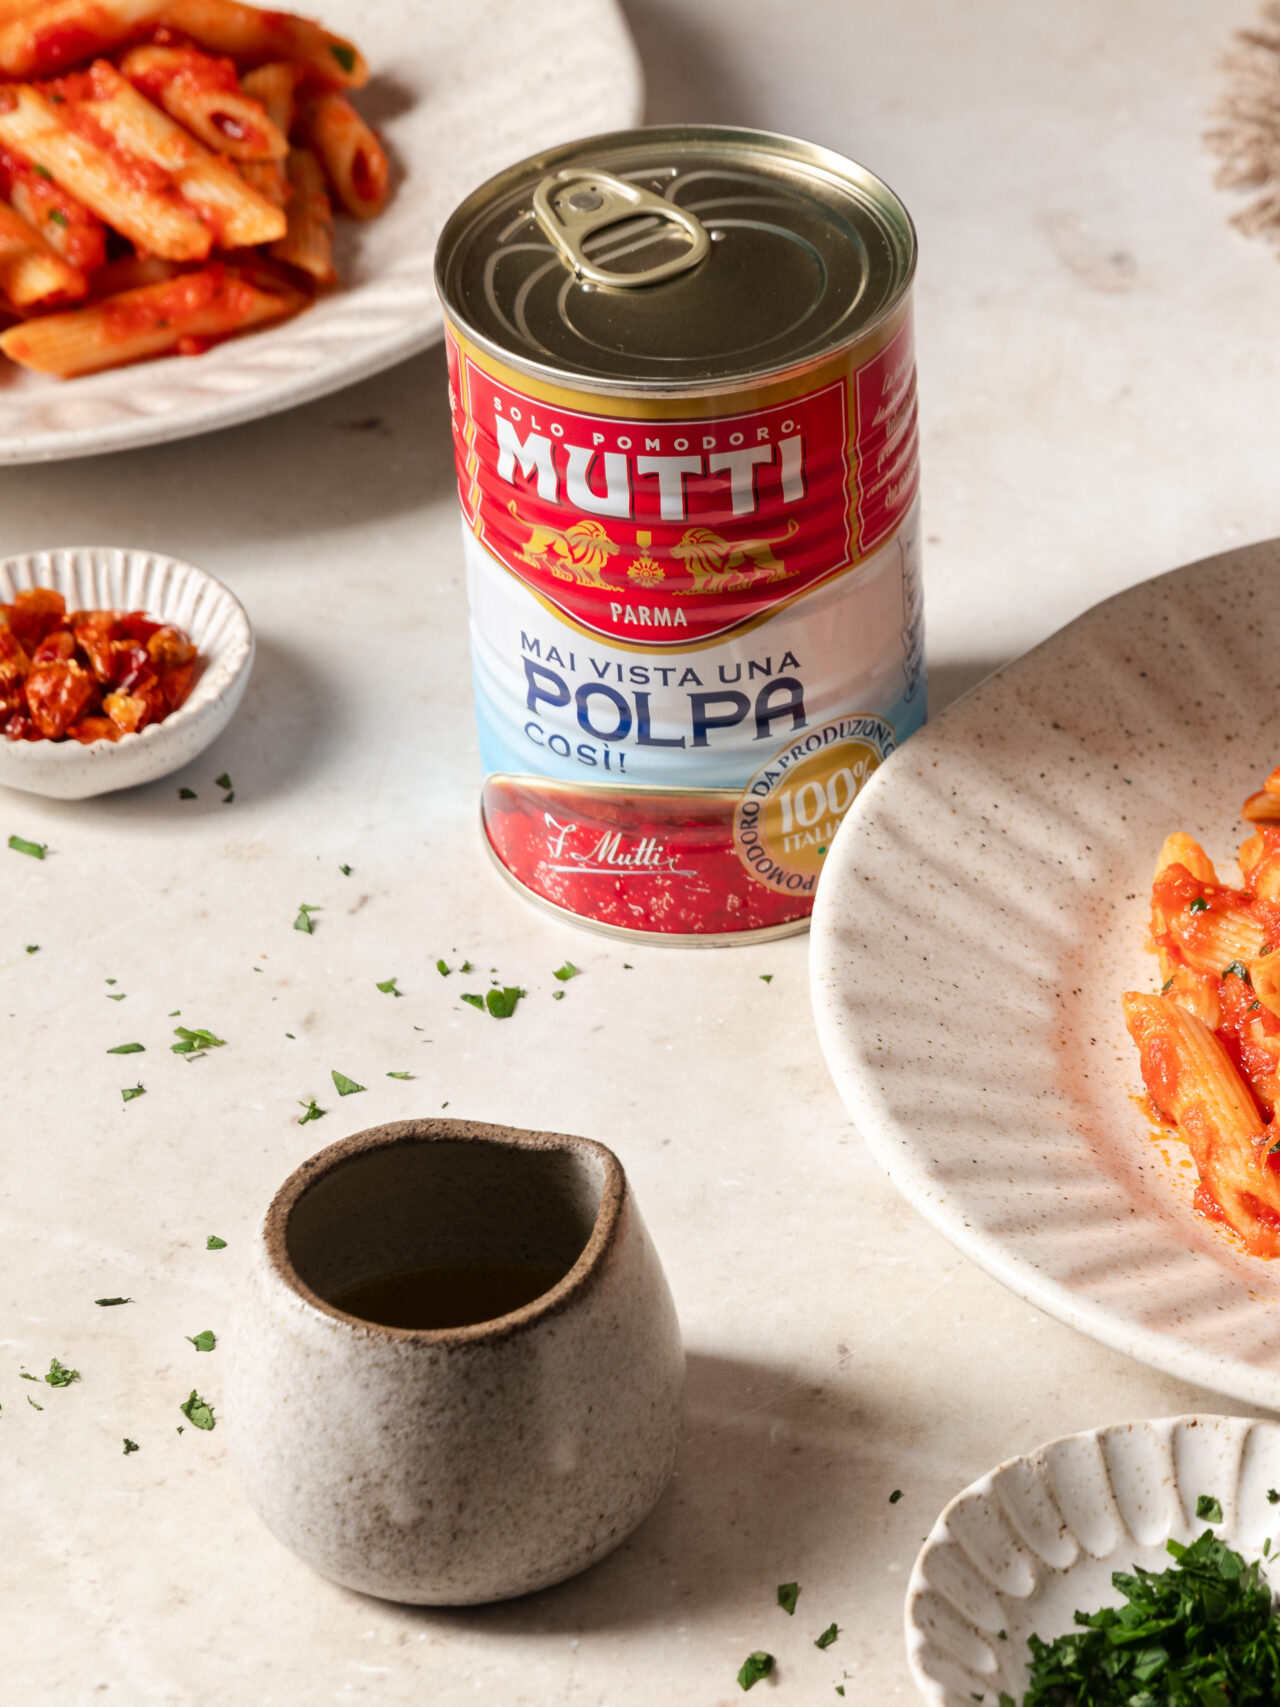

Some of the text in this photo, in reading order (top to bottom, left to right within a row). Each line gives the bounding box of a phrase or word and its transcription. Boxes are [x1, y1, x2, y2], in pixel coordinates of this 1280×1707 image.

[493, 396, 564, 435] SOLO
[494, 415, 807, 521] MUTTI
[610, 602, 688, 628] PARMA
[520, 630, 802, 687] MAI VISTA UNA
[521, 656, 808, 748] POLPA
[524, 721, 626, 774] COSÌ!
[751, 770, 781, 798] DA
[779, 755, 875, 834] 100%
[570, 830, 674, 873] Mutti
[740, 801, 817, 891] POMODORO
